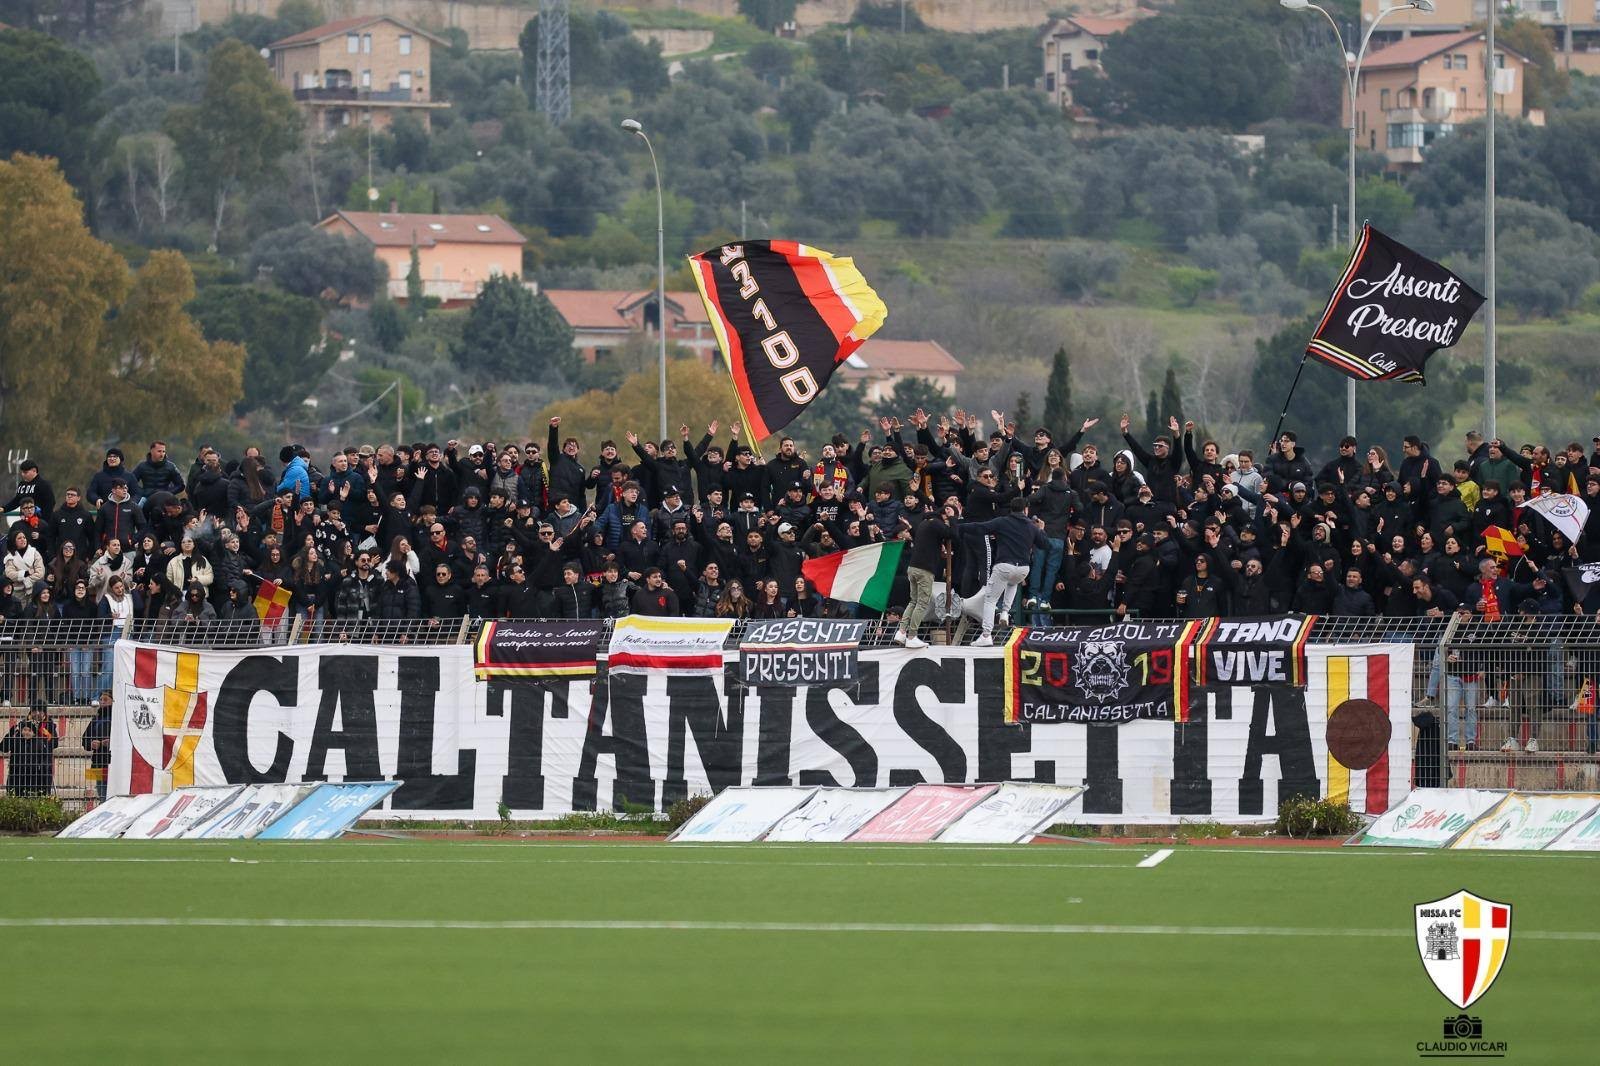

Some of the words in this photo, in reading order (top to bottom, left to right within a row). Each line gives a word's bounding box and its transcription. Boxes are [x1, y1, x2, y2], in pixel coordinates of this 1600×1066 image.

[1347, 262, 1461, 304] Assenti
[1346, 303, 1458, 346] Presenti
[747, 620, 863, 643] ASSENTI
[1029, 630, 1081, 642] CANI
[1088, 624, 1179, 642] SCIOLTI
[1217, 618, 1302, 643] TANO
[497, 640, 541, 652] sempre
[543, 640, 566, 648] con
[567, 639, 590, 647] noi
[746, 651, 852, 682] PRESENTI
[1212, 650, 1286, 682] VIVE
[1023, 701, 1168, 721] CALTANISSETTA
